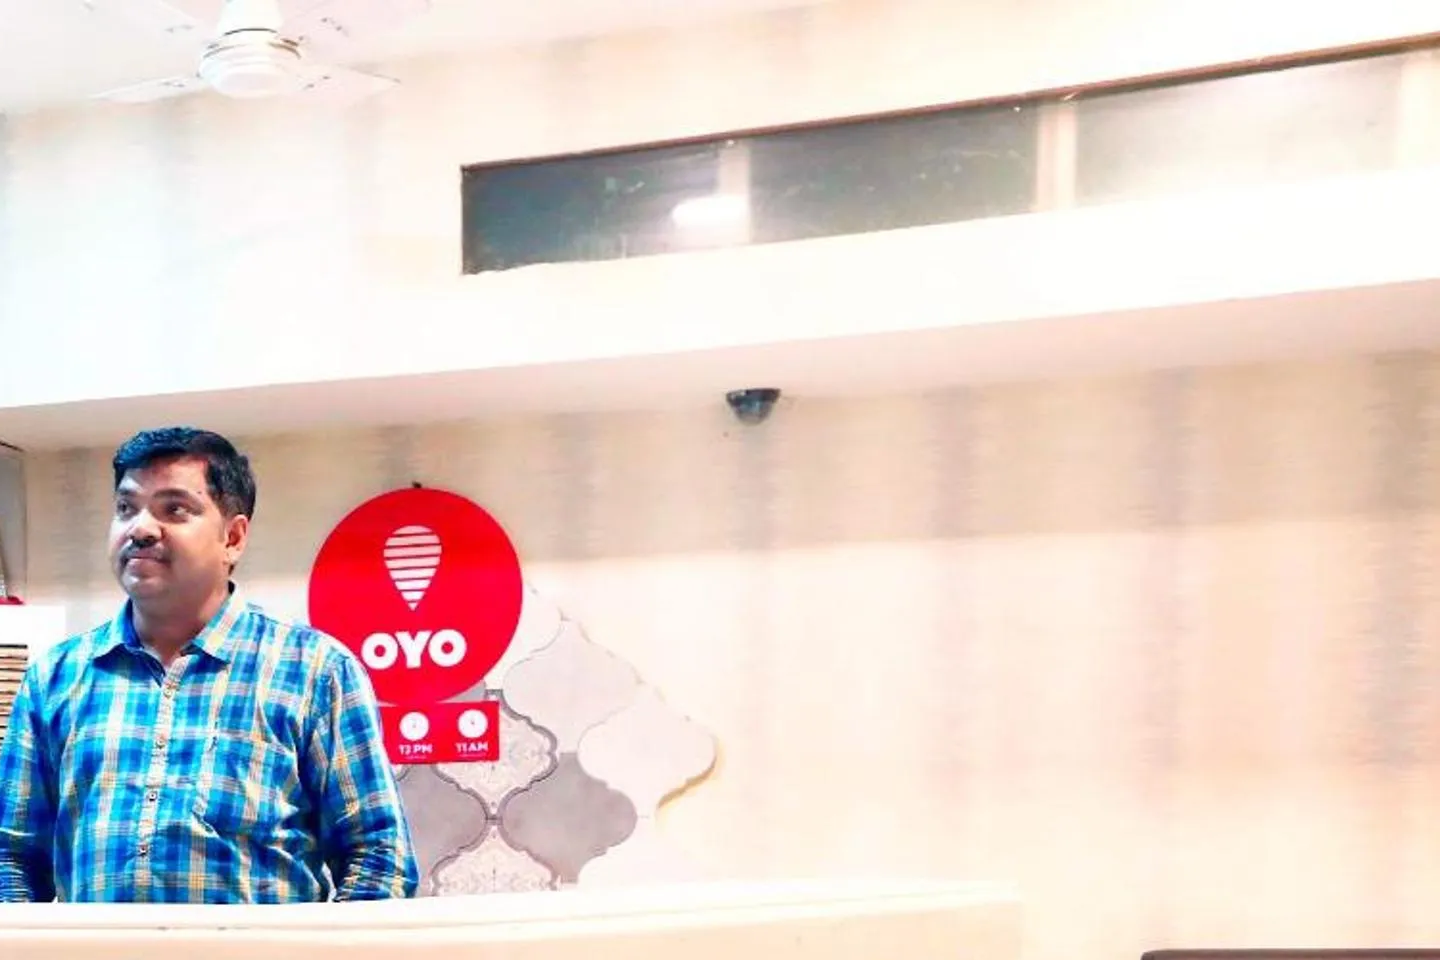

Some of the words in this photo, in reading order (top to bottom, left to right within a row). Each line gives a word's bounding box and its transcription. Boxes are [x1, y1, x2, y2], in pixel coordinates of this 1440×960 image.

[361, 629, 467, 671] OYO
[413, 743, 433, 754] PM
[468, 741, 489, 752] AM
